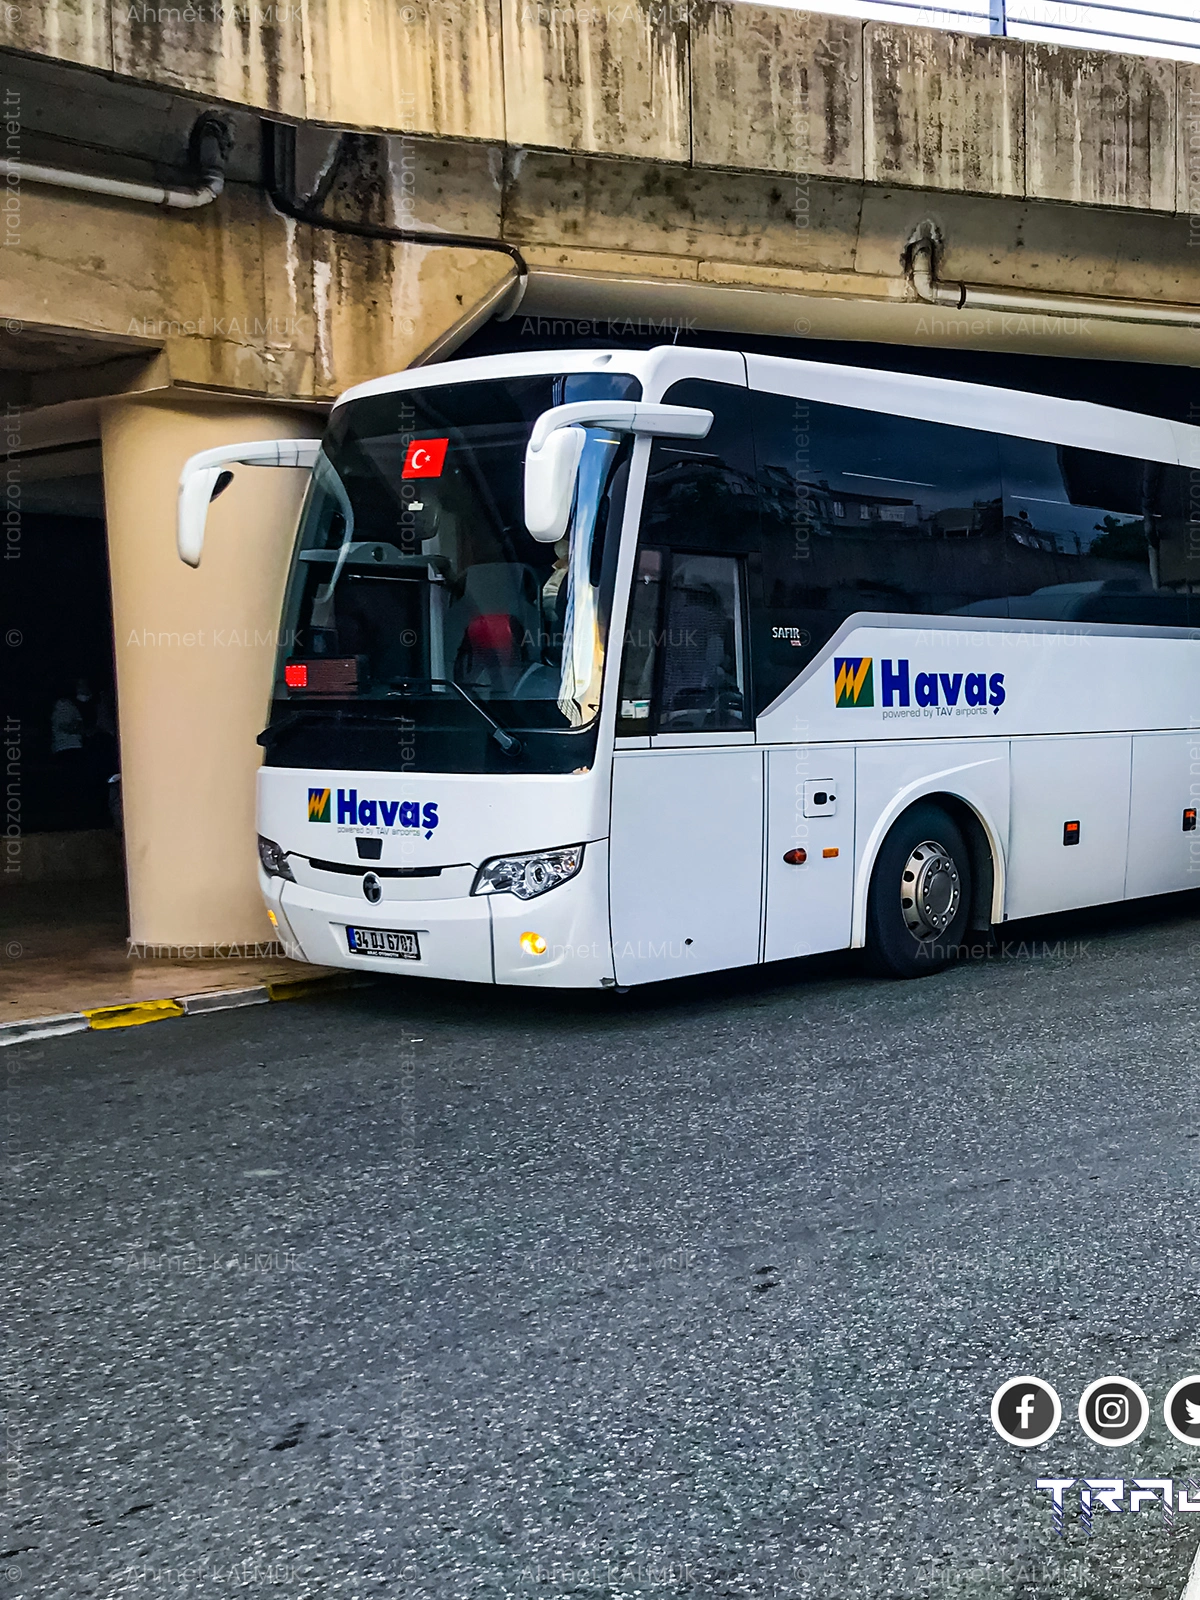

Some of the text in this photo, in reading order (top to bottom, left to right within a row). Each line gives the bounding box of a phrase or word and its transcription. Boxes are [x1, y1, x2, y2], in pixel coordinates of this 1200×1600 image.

[772, 626, 801, 639] SAFIR
[881, 659, 1006, 715] Havaş
[882, 707, 988, 720] powered by TAV airports
[336, 788, 439, 840] Havaş
[376, 826, 389, 835] TAV
[355, 930, 369, 948] 34
[370, 932, 385, 949] DJ
